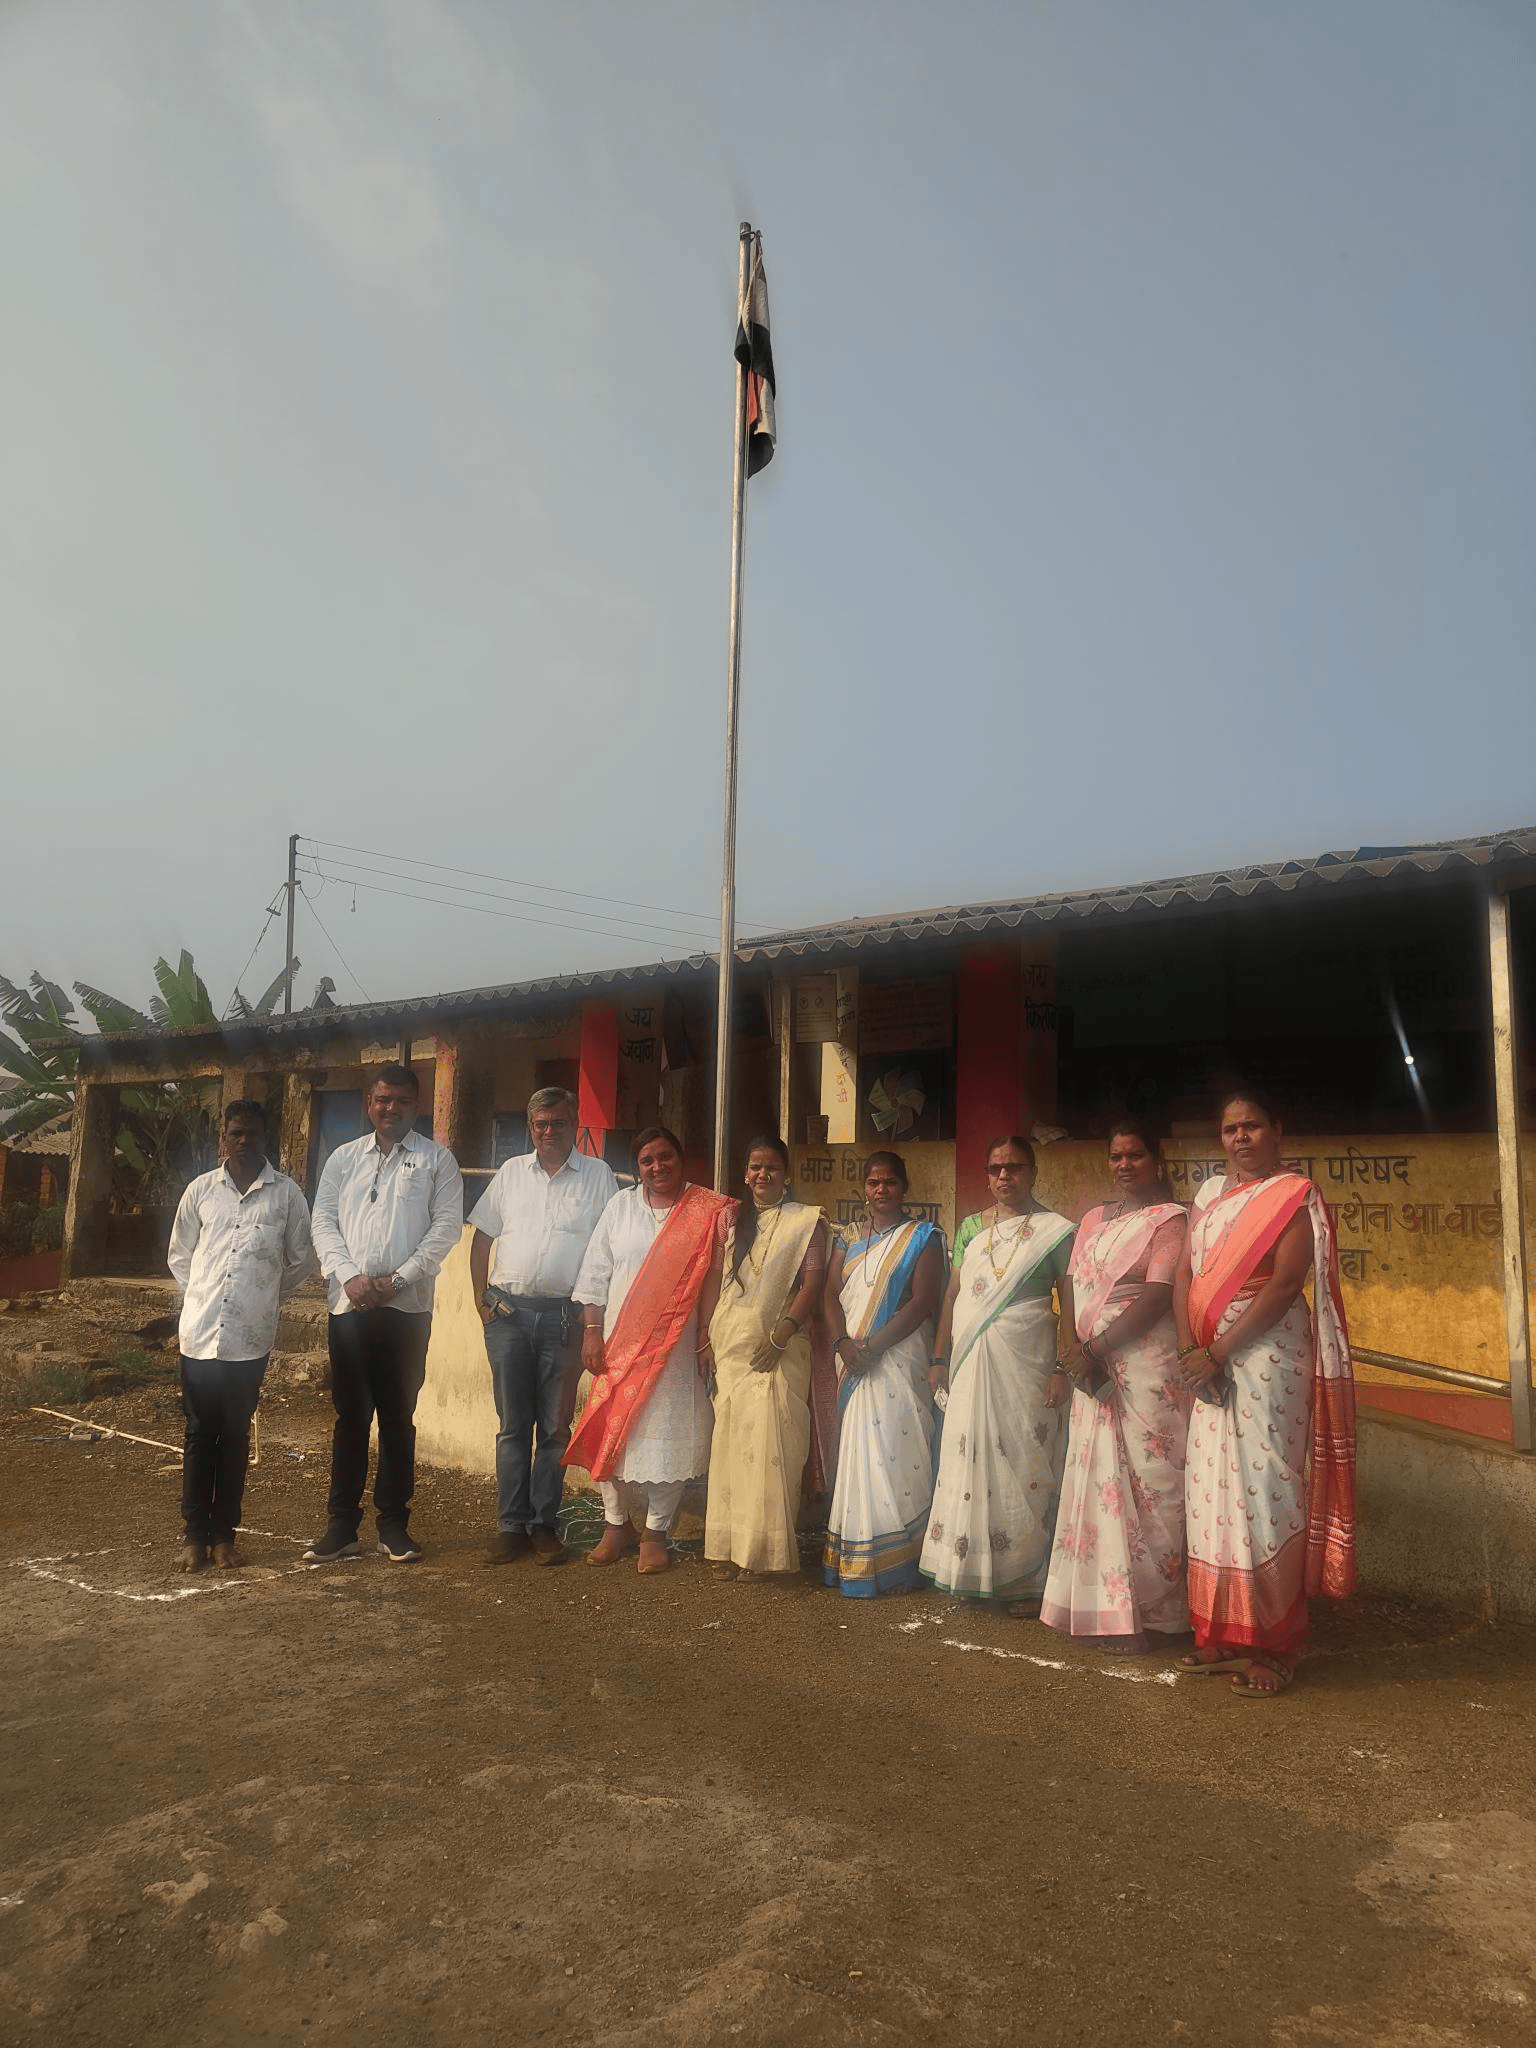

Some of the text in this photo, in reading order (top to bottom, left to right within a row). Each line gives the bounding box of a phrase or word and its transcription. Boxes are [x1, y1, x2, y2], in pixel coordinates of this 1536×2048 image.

[624, 1007, 654, 1029] जय
[620, 1037, 656, 1064] जवान
[800, 1149, 836, 1183] सारे
[1323, 1146, 1417, 1186] परिषद
